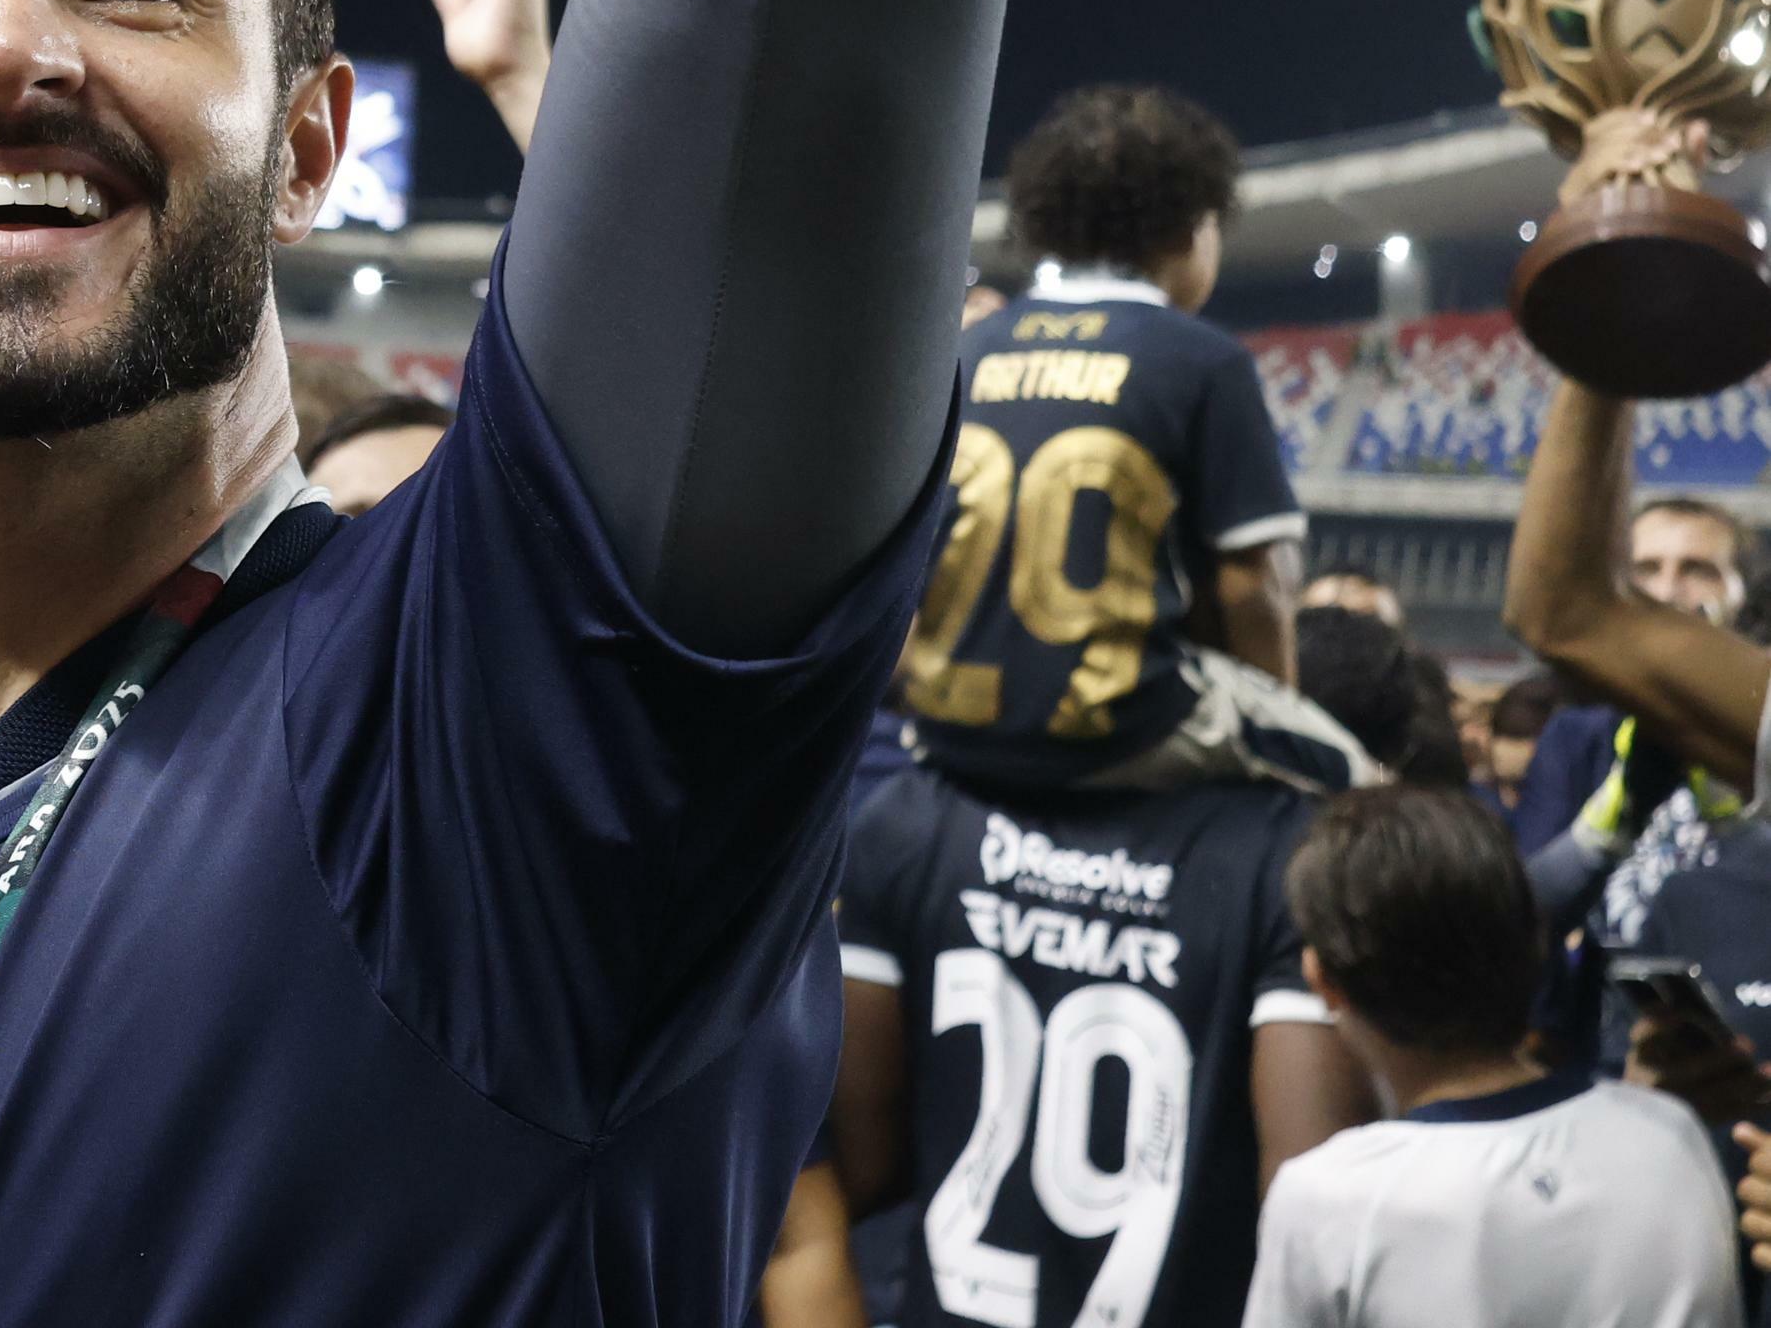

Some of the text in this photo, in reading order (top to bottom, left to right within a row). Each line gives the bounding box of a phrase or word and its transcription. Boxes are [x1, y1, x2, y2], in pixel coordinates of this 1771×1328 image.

[970, 349, 1131, 405] ARTHUR
[900, 422, 1177, 736] 29
[53, 680, 145, 789] 2025
[959, 889, 1181, 989] EVEMAR
[924, 947, 1193, 1328] 29
